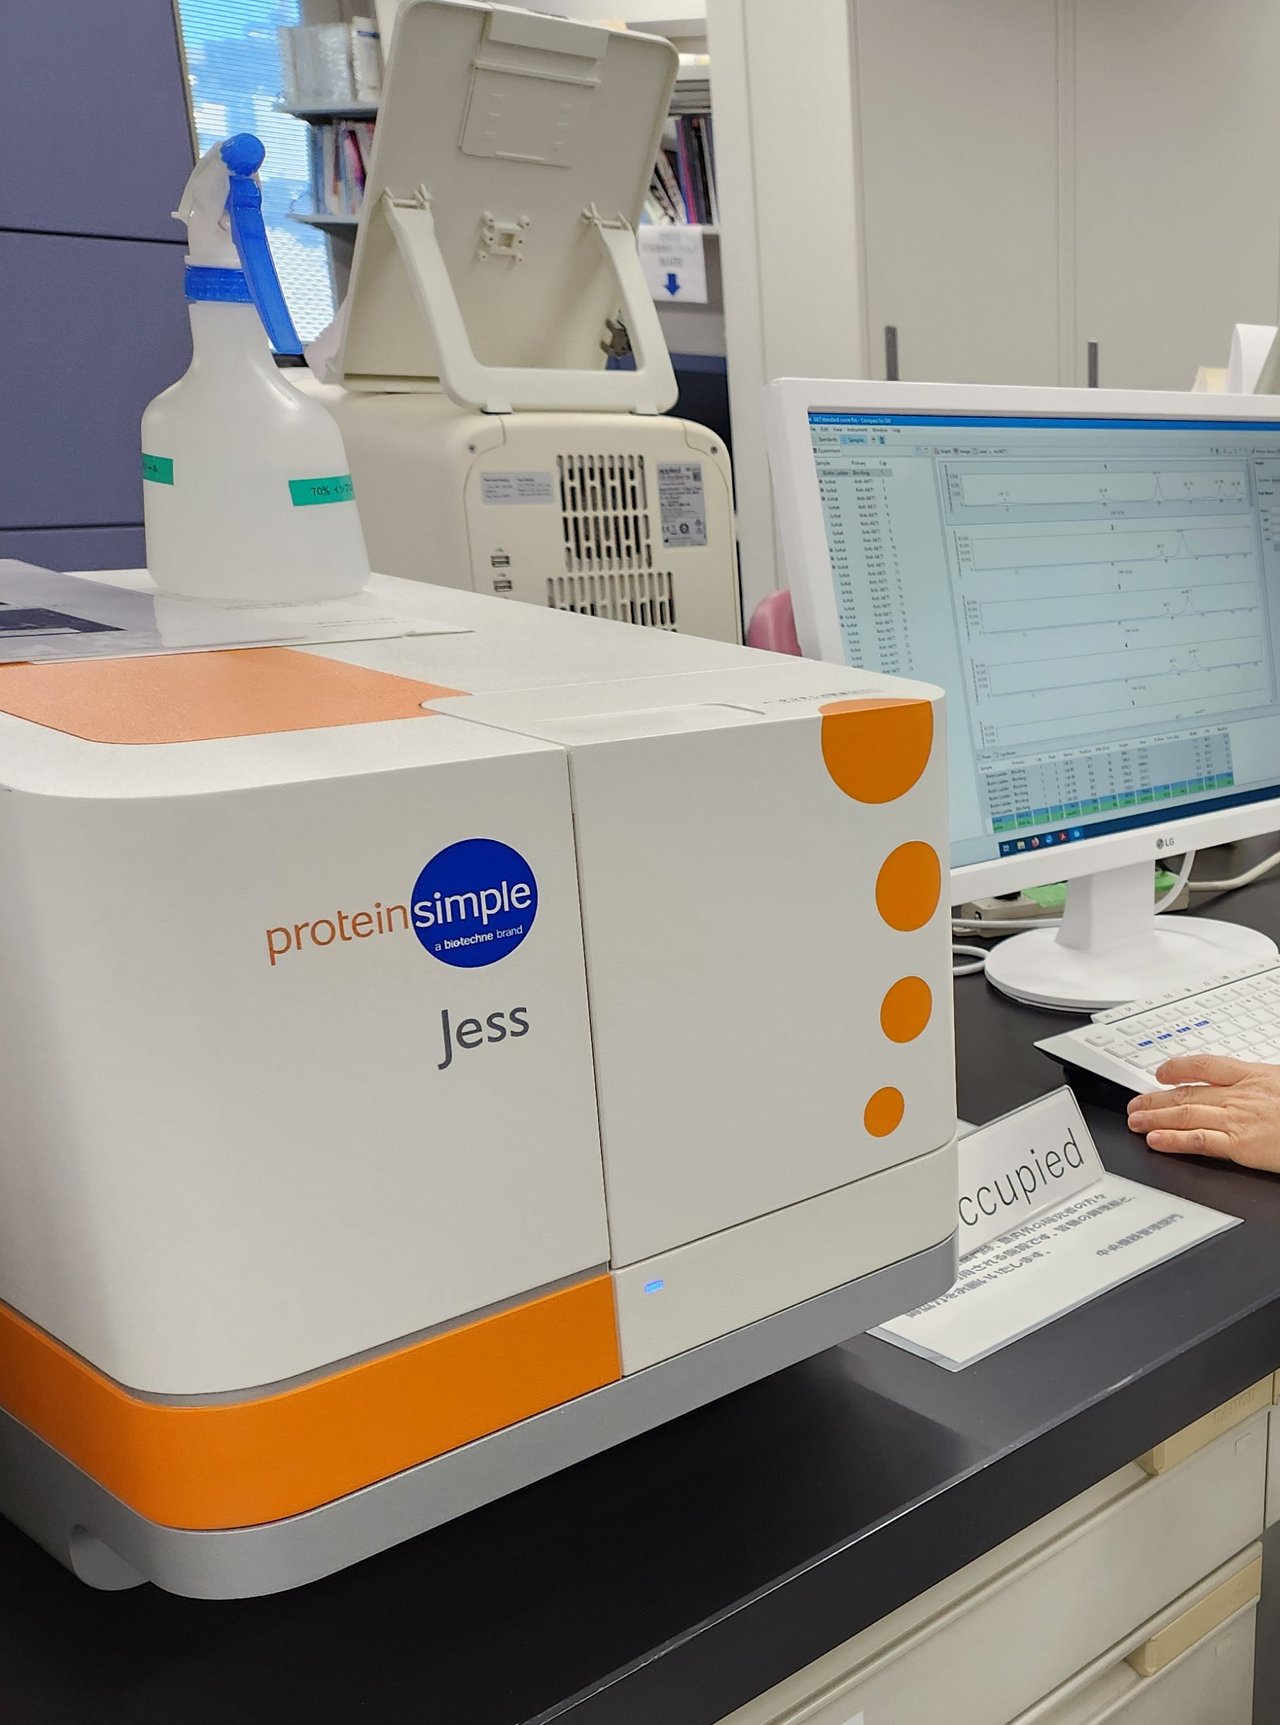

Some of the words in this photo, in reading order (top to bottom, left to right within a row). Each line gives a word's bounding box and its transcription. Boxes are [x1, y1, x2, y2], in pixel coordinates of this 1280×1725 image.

[311, 486, 331, 496] 70%
[434, 943, 442, 952] a
[496, 924, 523, 939] brand
[437, 1005, 530, 1070] Jess
[958, 1127, 1084, 1226] ccupied
